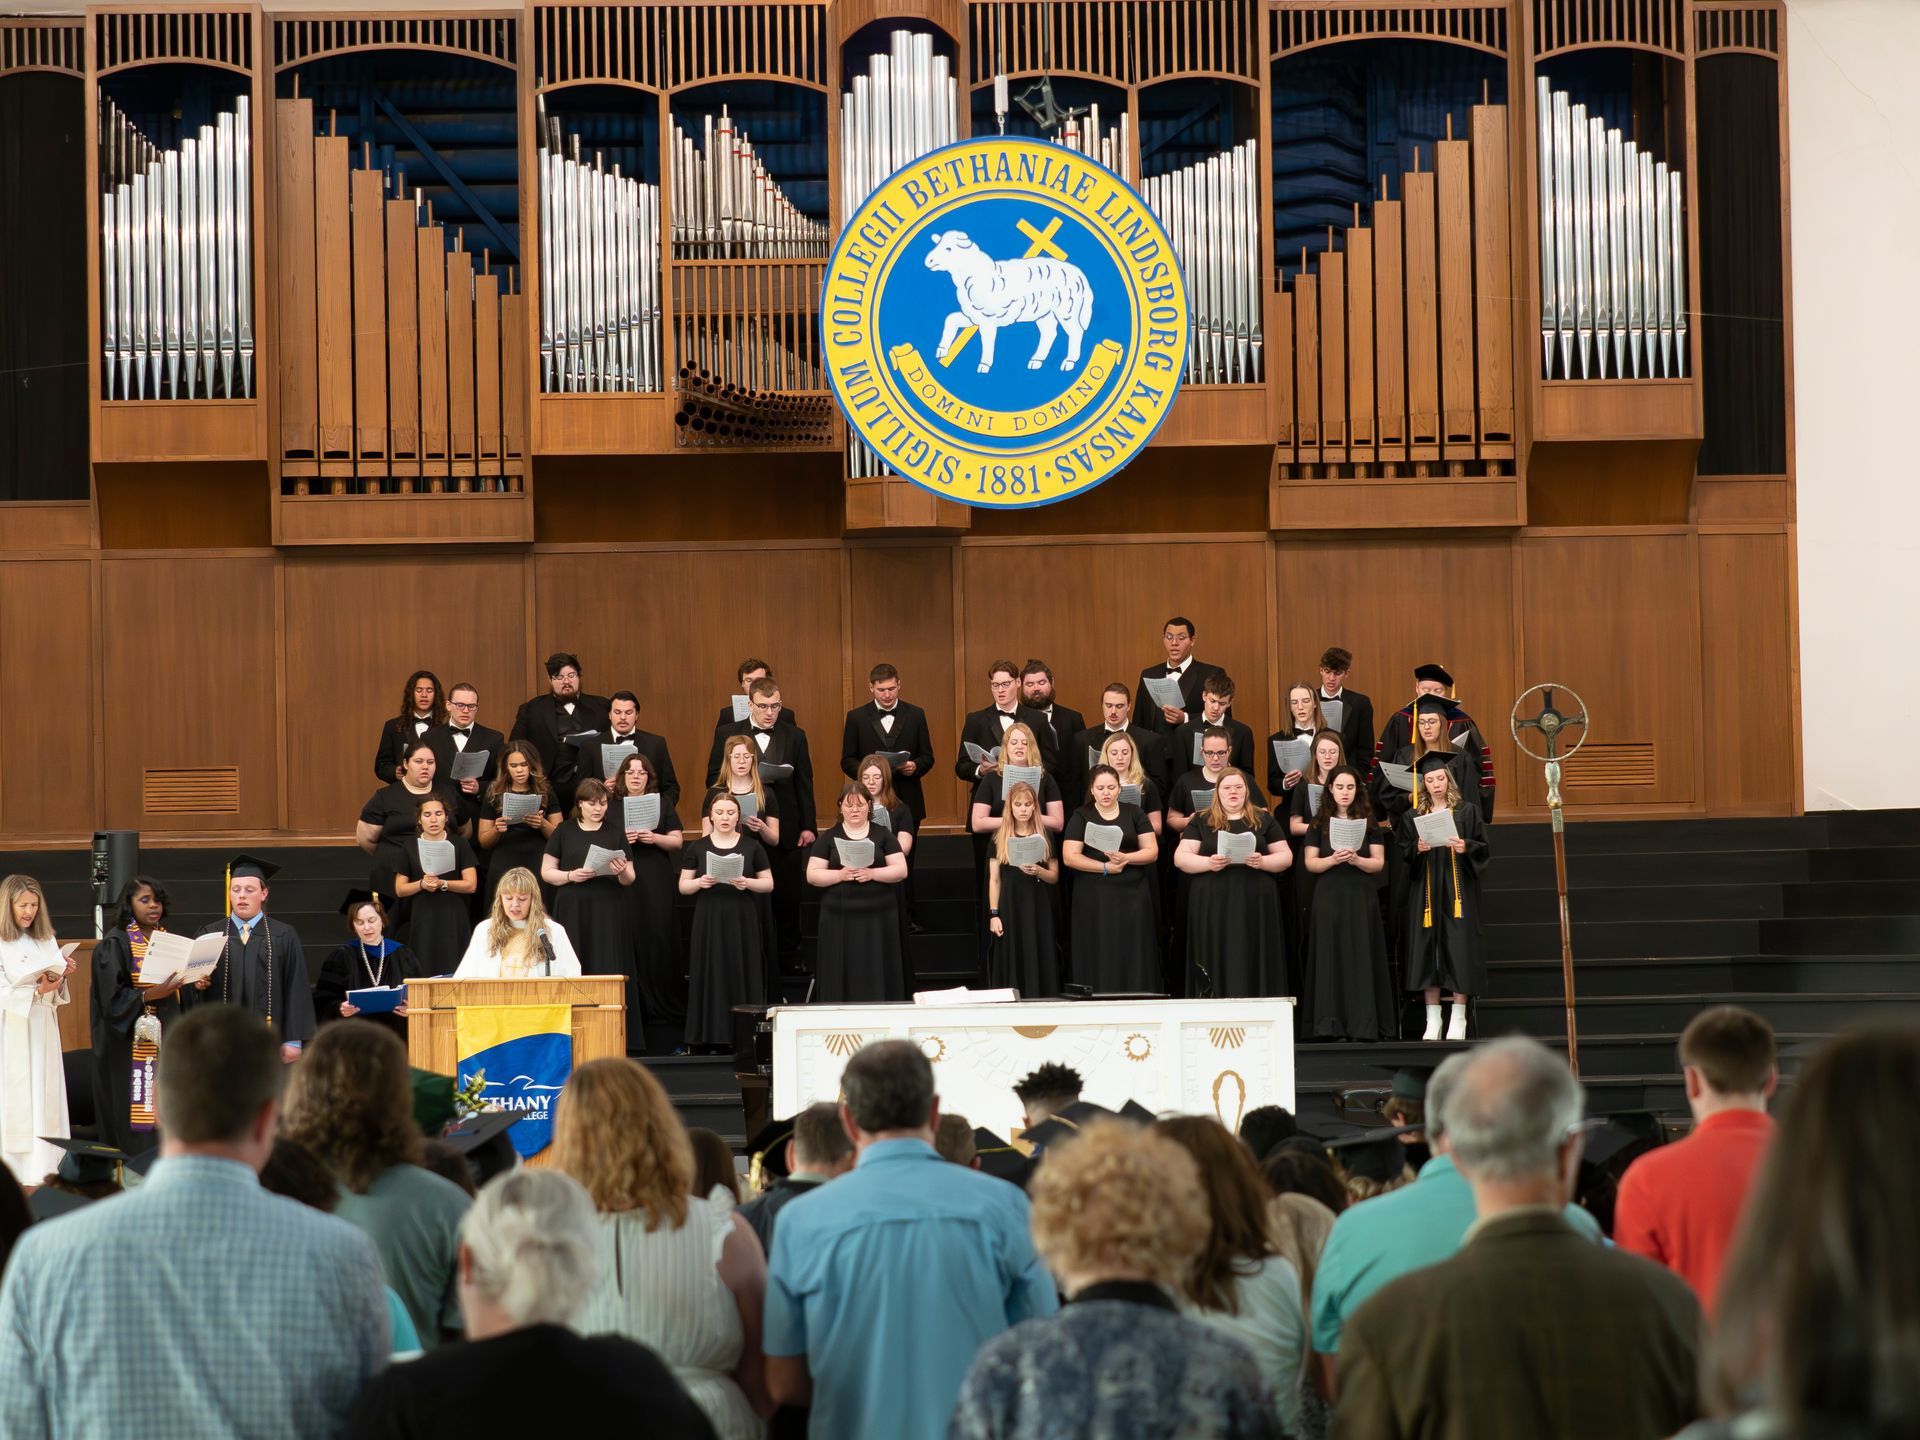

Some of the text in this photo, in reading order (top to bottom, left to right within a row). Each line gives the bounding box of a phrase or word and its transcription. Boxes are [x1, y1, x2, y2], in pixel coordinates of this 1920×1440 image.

[831, 151, 1179, 485] SIGILLUM COLLEGII BETHANIAE LINDSBORG KANSAS
[907, 364, 1105, 432] DOMINI DOMINO
[475, 1095, 551, 1111] THANY
[523, 1111, 549, 1120] LEGE
